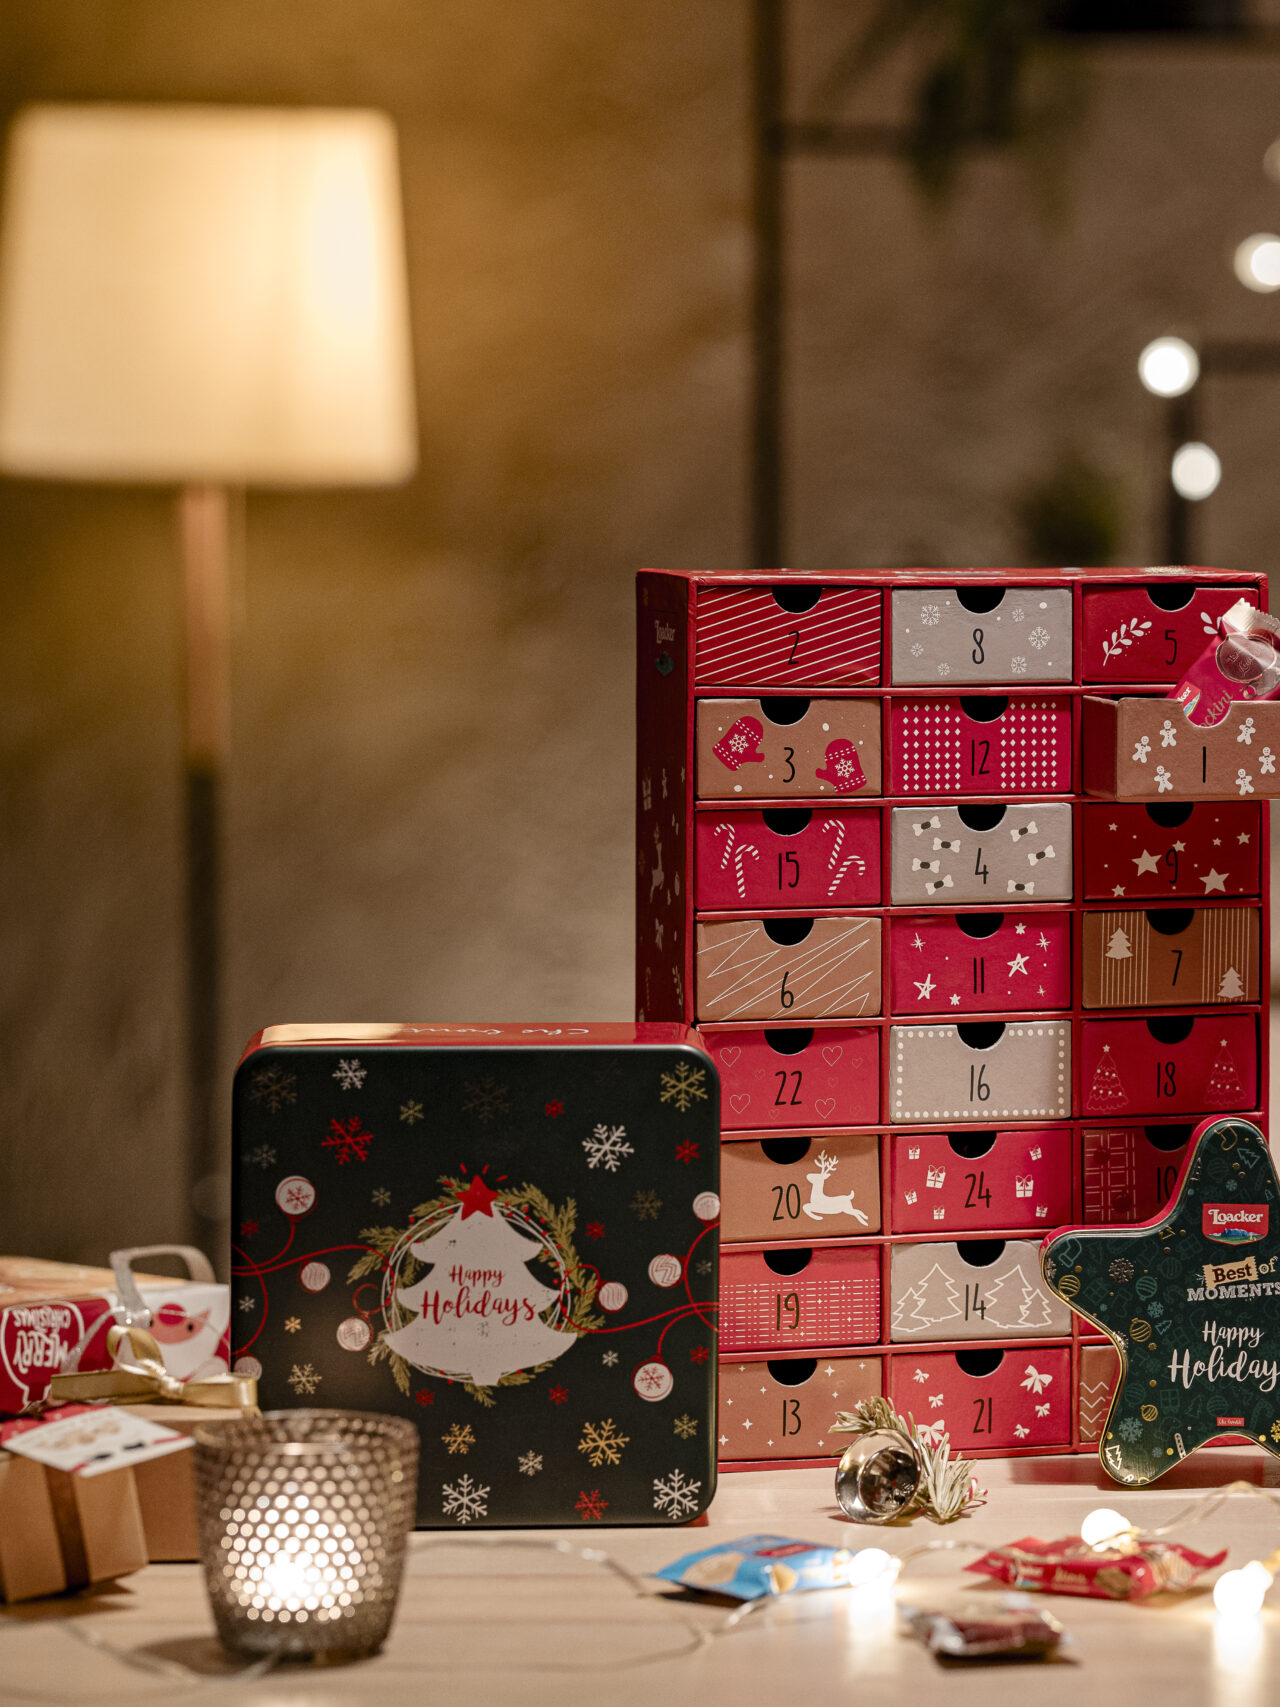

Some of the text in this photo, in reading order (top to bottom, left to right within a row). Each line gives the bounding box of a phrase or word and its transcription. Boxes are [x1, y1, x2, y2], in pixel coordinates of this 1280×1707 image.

[788, 631, 800, 666] 2
[972, 628, 985, 666] 8
[1165, 630, 1178, 666] 5
[782, 747, 795, 783] 3
[970, 740, 990, 776] 12
[1201, 746, 1207, 783] 1
[778, 852, 800, 890] 15
[974, 847, 989, 884] 4
[1166, 847, 1179, 886] 9
[972, 957, 985, 994] 11
[1170, 949, 1183, 986] 7
[781, 972, 794, 1009] 6
[774, 1071, 803, 1107] 22
[969, 1064, 990, 1101] 16
[1156, 1062, 1177, 1098] 18
[772, 1185, 801, 1221] 20
[964, 1173, 992, 1210] 24
[1208, 1209, 1264, 1225] Loacker
[449, 1264, 505, 1288] Happy
[1212, 1256, 1278, 1283] Best of
[421, 1286, 536, 1326] Holidays
[776, 1292, 800, 1330] 19
[964, 1285, 986, 1321] 14
[13, 1330, 69, 1374] MERRY
[1202, 1320, 1264, 1348] Happy
[782, 1399, 801, 1436] 13
[973, 1398, 993, 1434] 21
